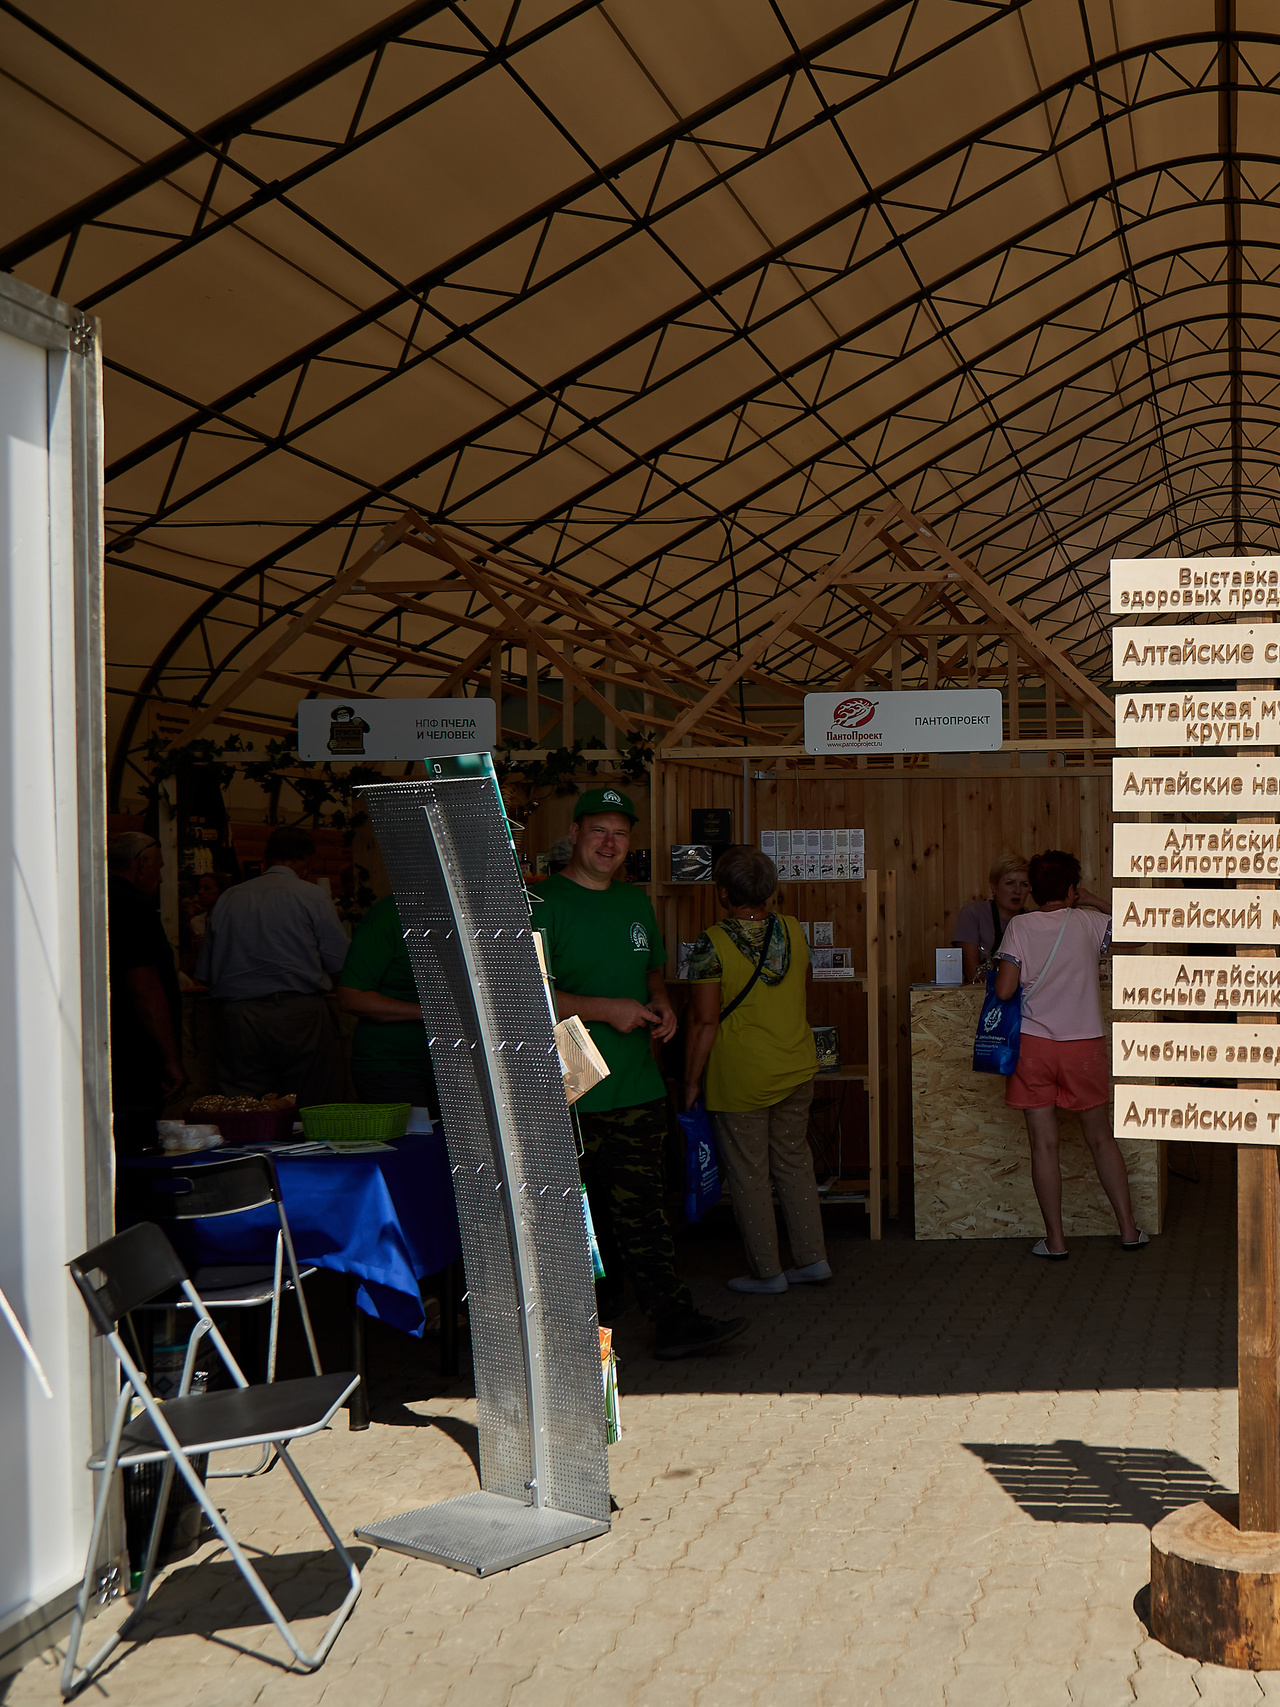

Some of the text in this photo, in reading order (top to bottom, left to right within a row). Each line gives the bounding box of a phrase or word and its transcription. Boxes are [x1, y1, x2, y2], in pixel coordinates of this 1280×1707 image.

[1178, 567, 1279, 586] Выставка
[1120, 587, 1221, 609] здоровых
[1122, 638, 1254, 666] Алтайские
[1123, 695, 1252, 723] Алтайская
[415, 718, 477, 728] НПФ ПЧЕЛА
[914, 715, 991, 726] ПАНТОПРОЕКТ
[417, 731, 476, 740] И ЧЕЛОВЕК
[826, 731, 883, 742] ПантоПроект
[1186, 721, 1260, 745] крупы
[1122, 771, 1243, 796] Алтайские
[1122, 901, 1262, 930] Алтайский
[1122, 985, 1206, 1005] мясные
[1121, 1039, 1218, 1062] Учебные
[1123, 1100, 1258, 1131] Алтайские
